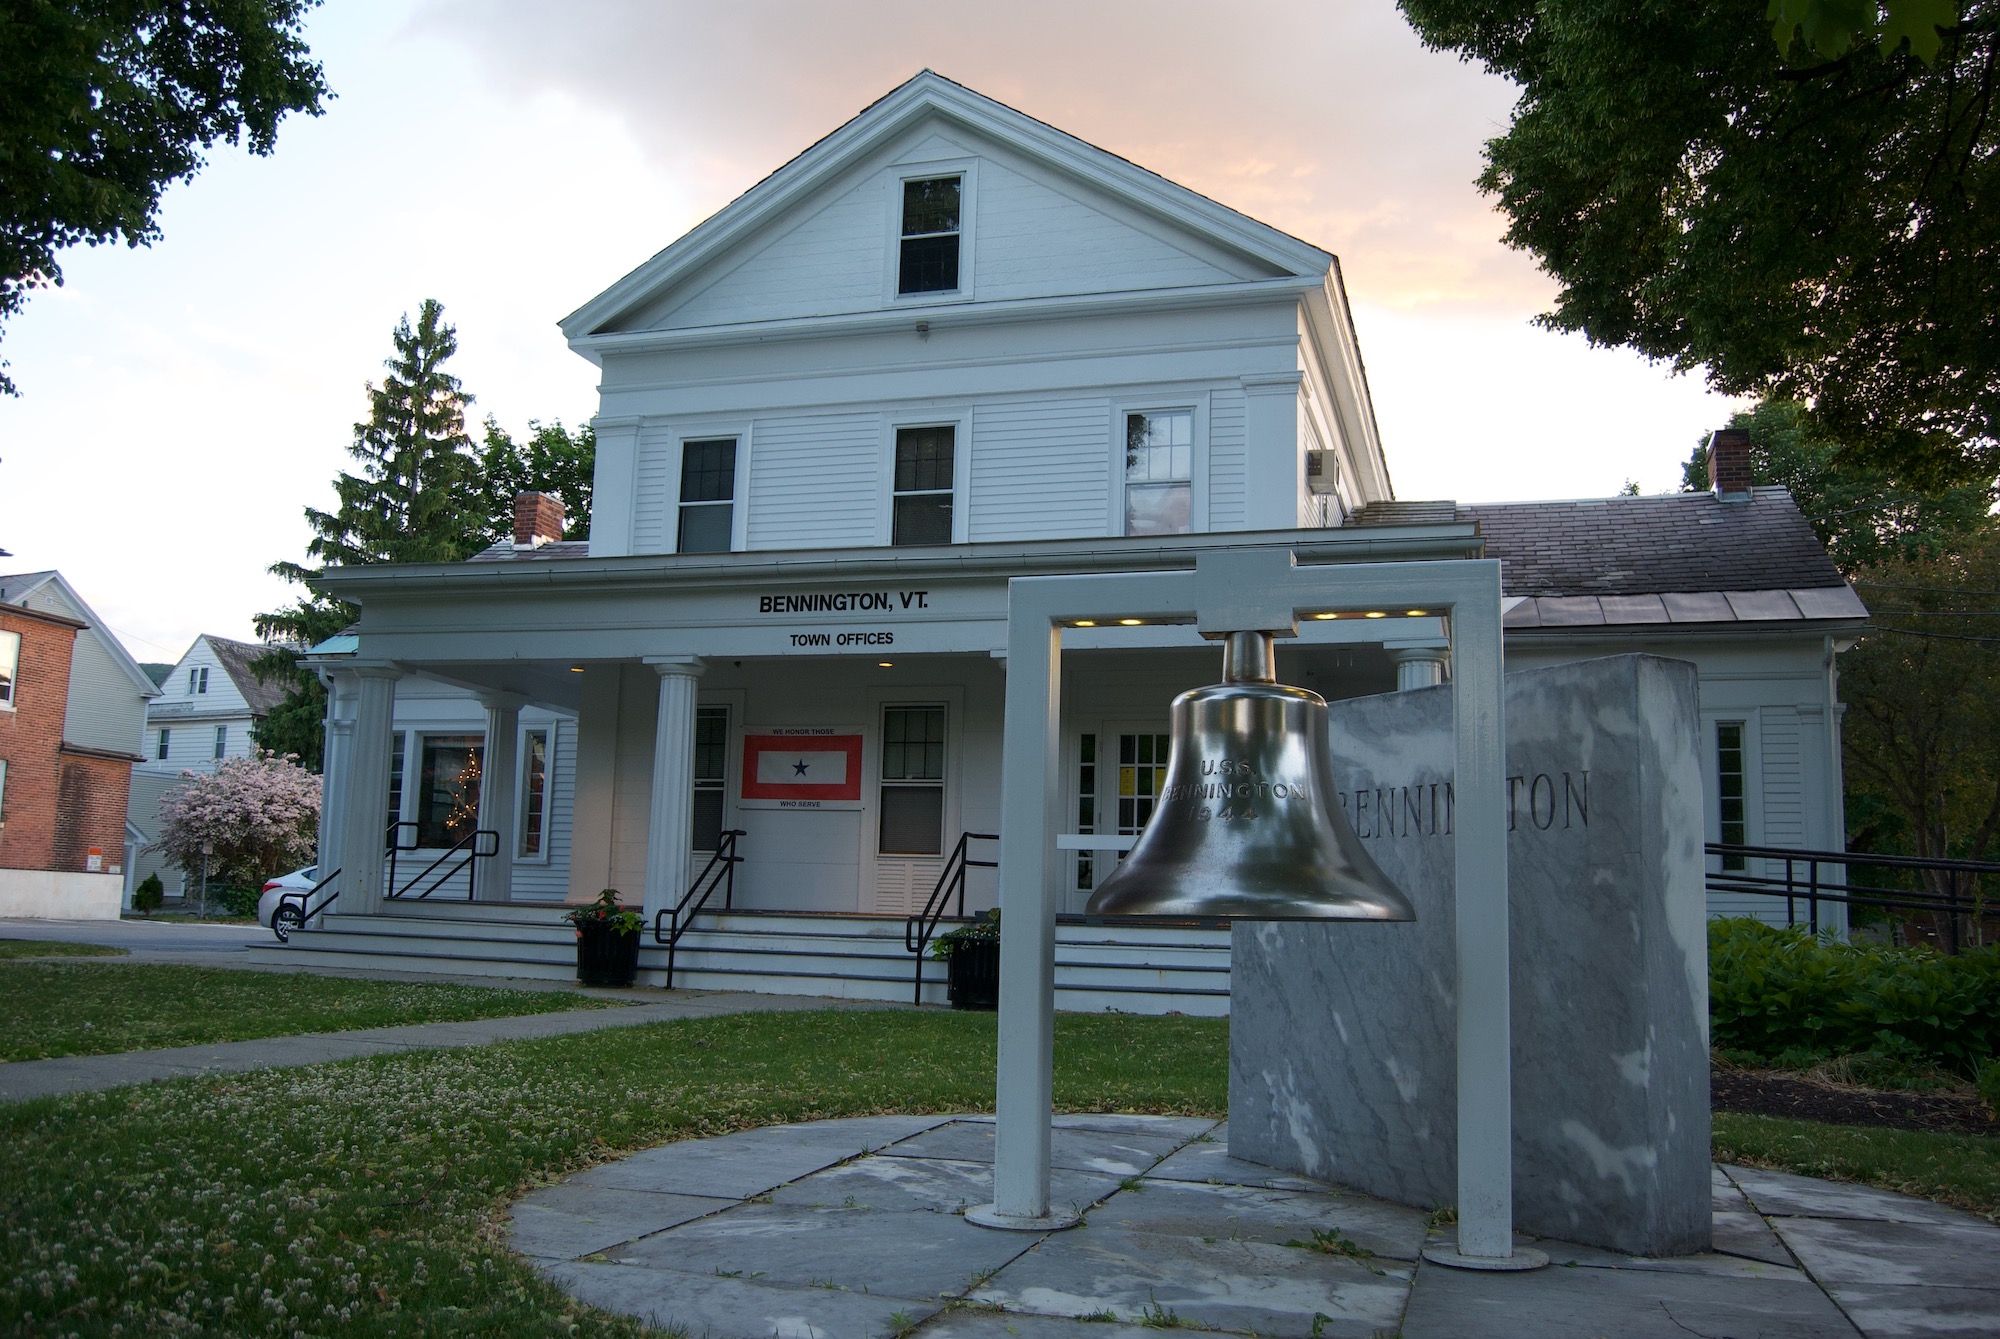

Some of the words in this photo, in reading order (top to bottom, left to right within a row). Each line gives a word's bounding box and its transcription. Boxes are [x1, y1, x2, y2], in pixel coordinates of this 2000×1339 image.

[759, 592, 893, 613] BENNINGTON,
[899, 591, 929, 609] VT.
[790, 634, 831, 647] TOWN
[836, 632, 894, 646] OFFICES
[1201, 759, 1257, 776] U.S.S.
[1162, 782, 1305, 802] BENNINGTON
[1338, 770, 1590, 839] ENNITON
